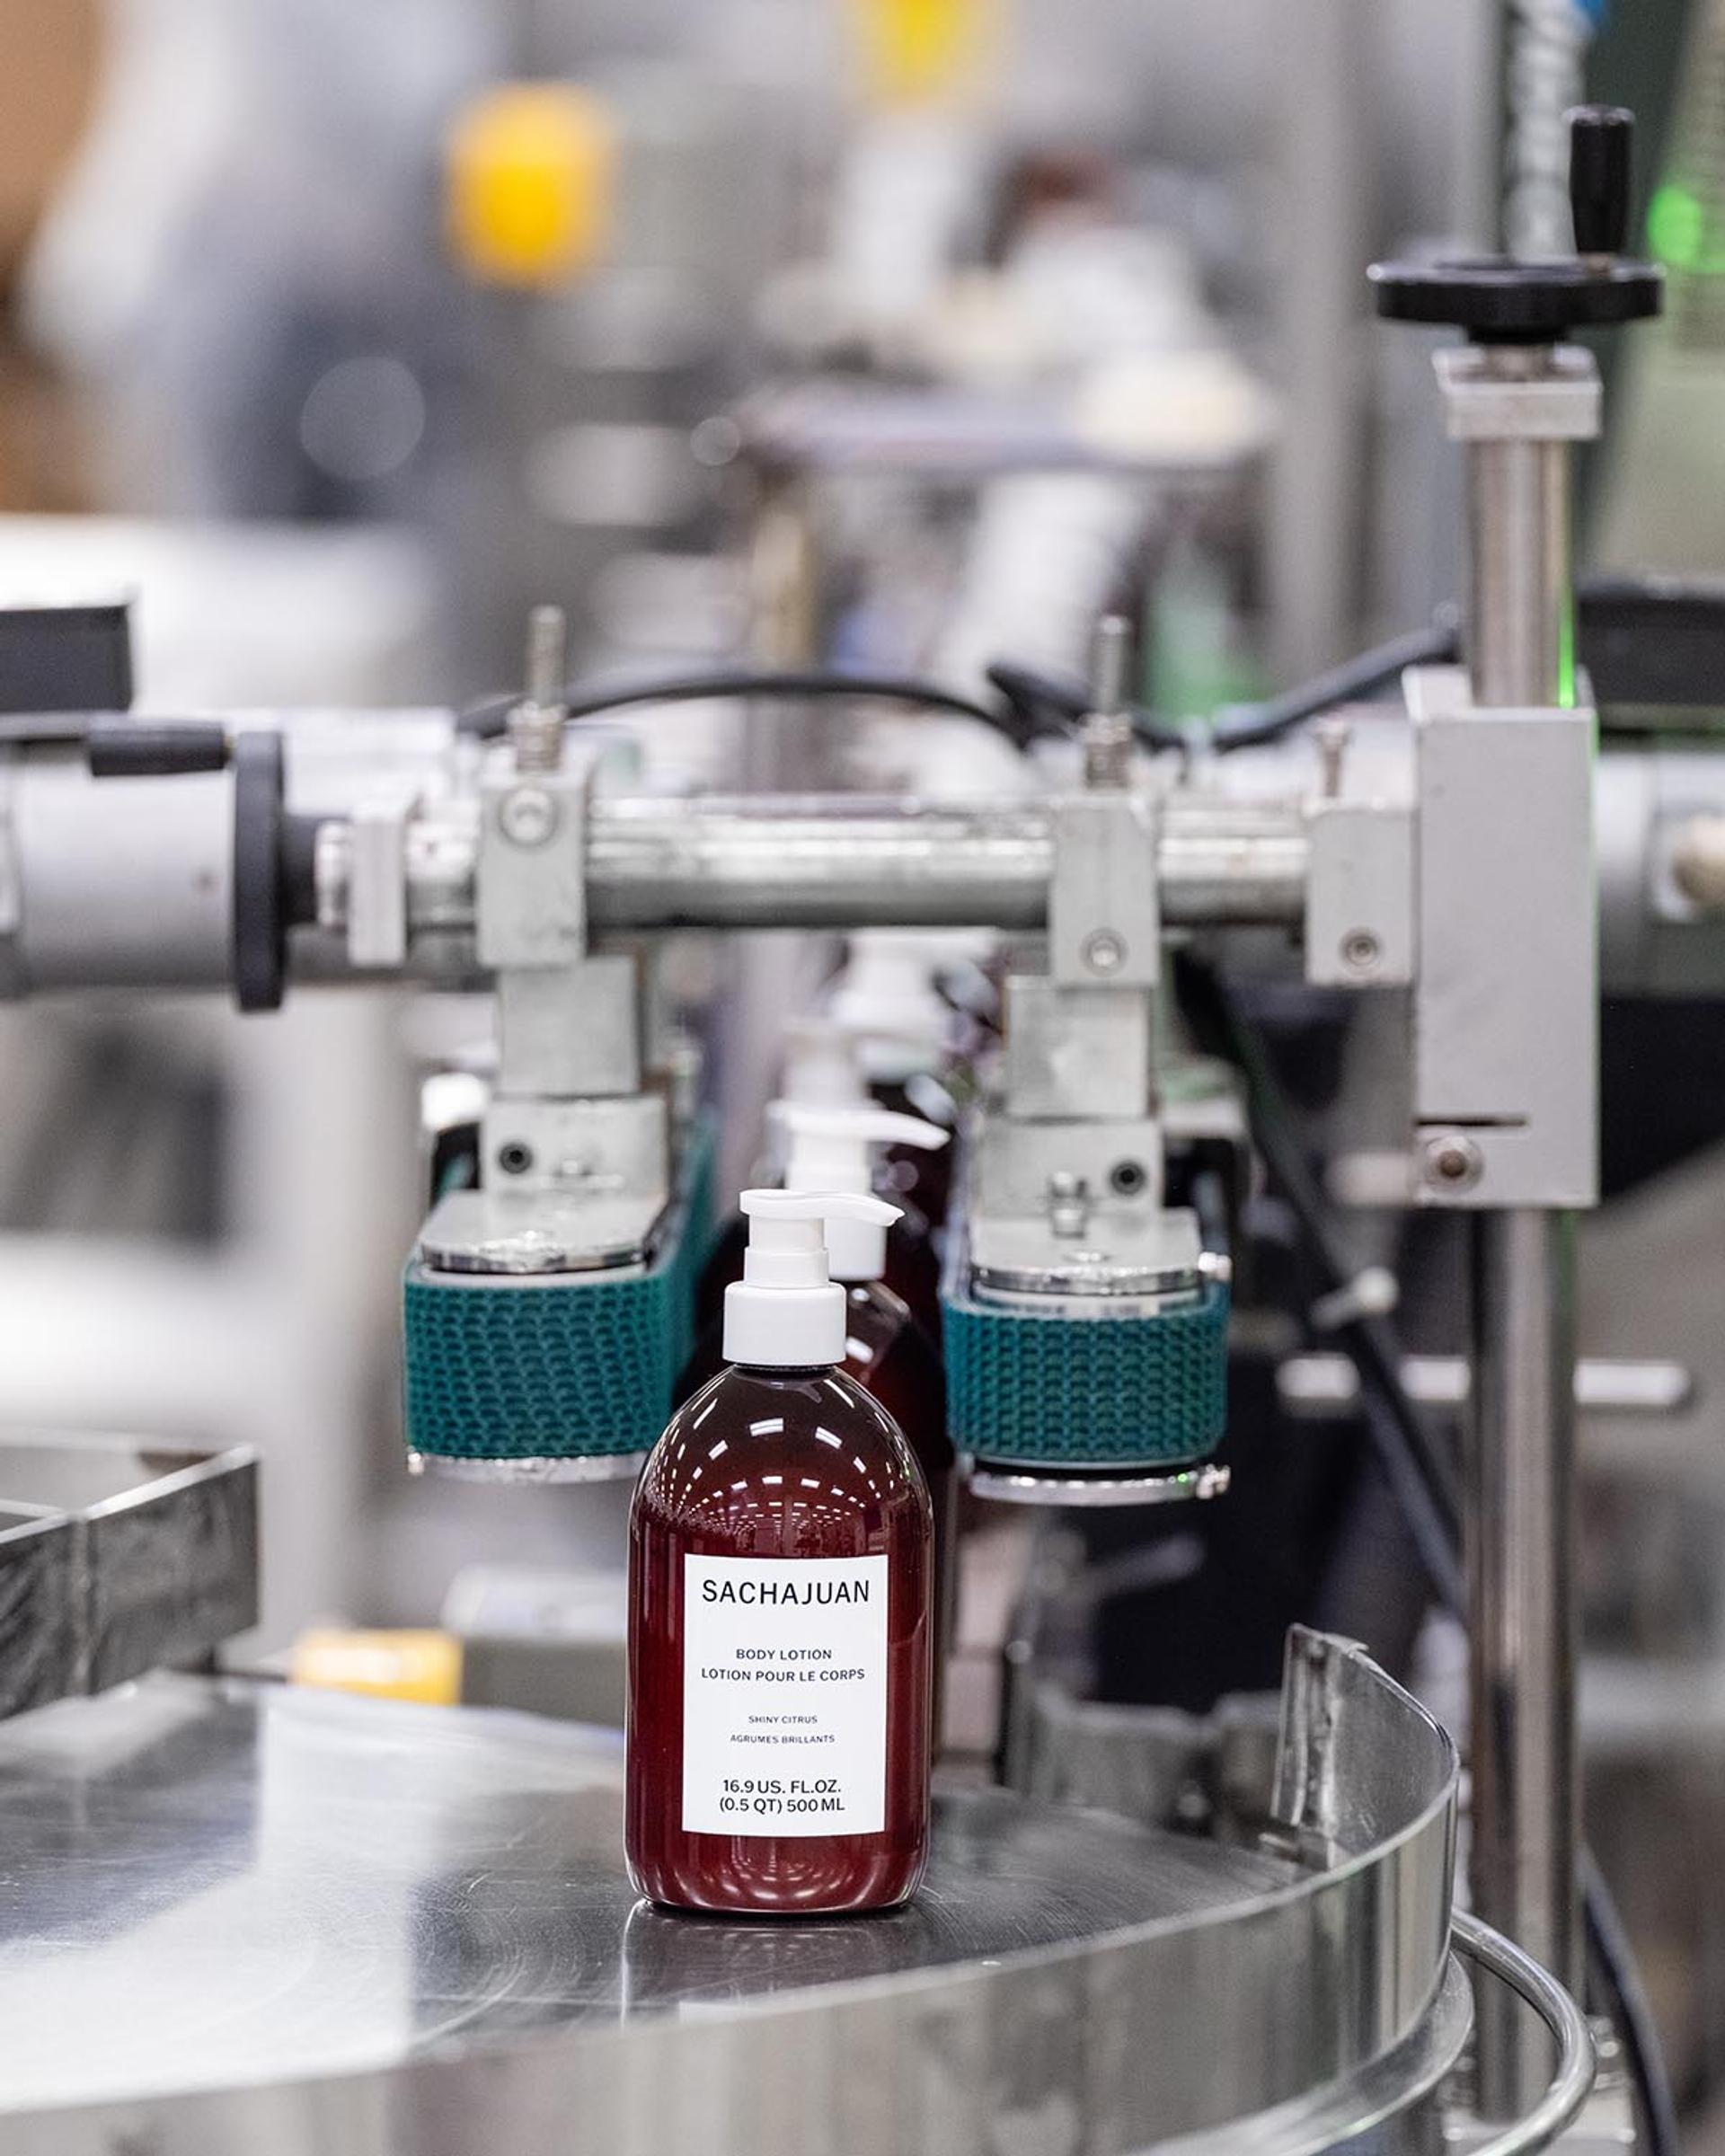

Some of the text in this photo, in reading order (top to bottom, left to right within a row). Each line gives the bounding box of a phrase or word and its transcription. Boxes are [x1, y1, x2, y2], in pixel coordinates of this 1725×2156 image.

[702, 1578, 870, 1605] SACHAJUAN
[736, 1648, 832, 1661] BODY LOTION
[701, 1667, 865, 1683] LOTION POUR LE CORPS
[748, 1715, 818, 1724] SHINY CITRUS
[730, 1734, 836, 1744] AGRUMES BRILLANTS
[722, 1779, 755, 1794] 16.9
[756, 1780, 786, 1795] US.
[719, 1796, 750, 1813] (0.5
[753, 1798, 783, 1816] QT)
